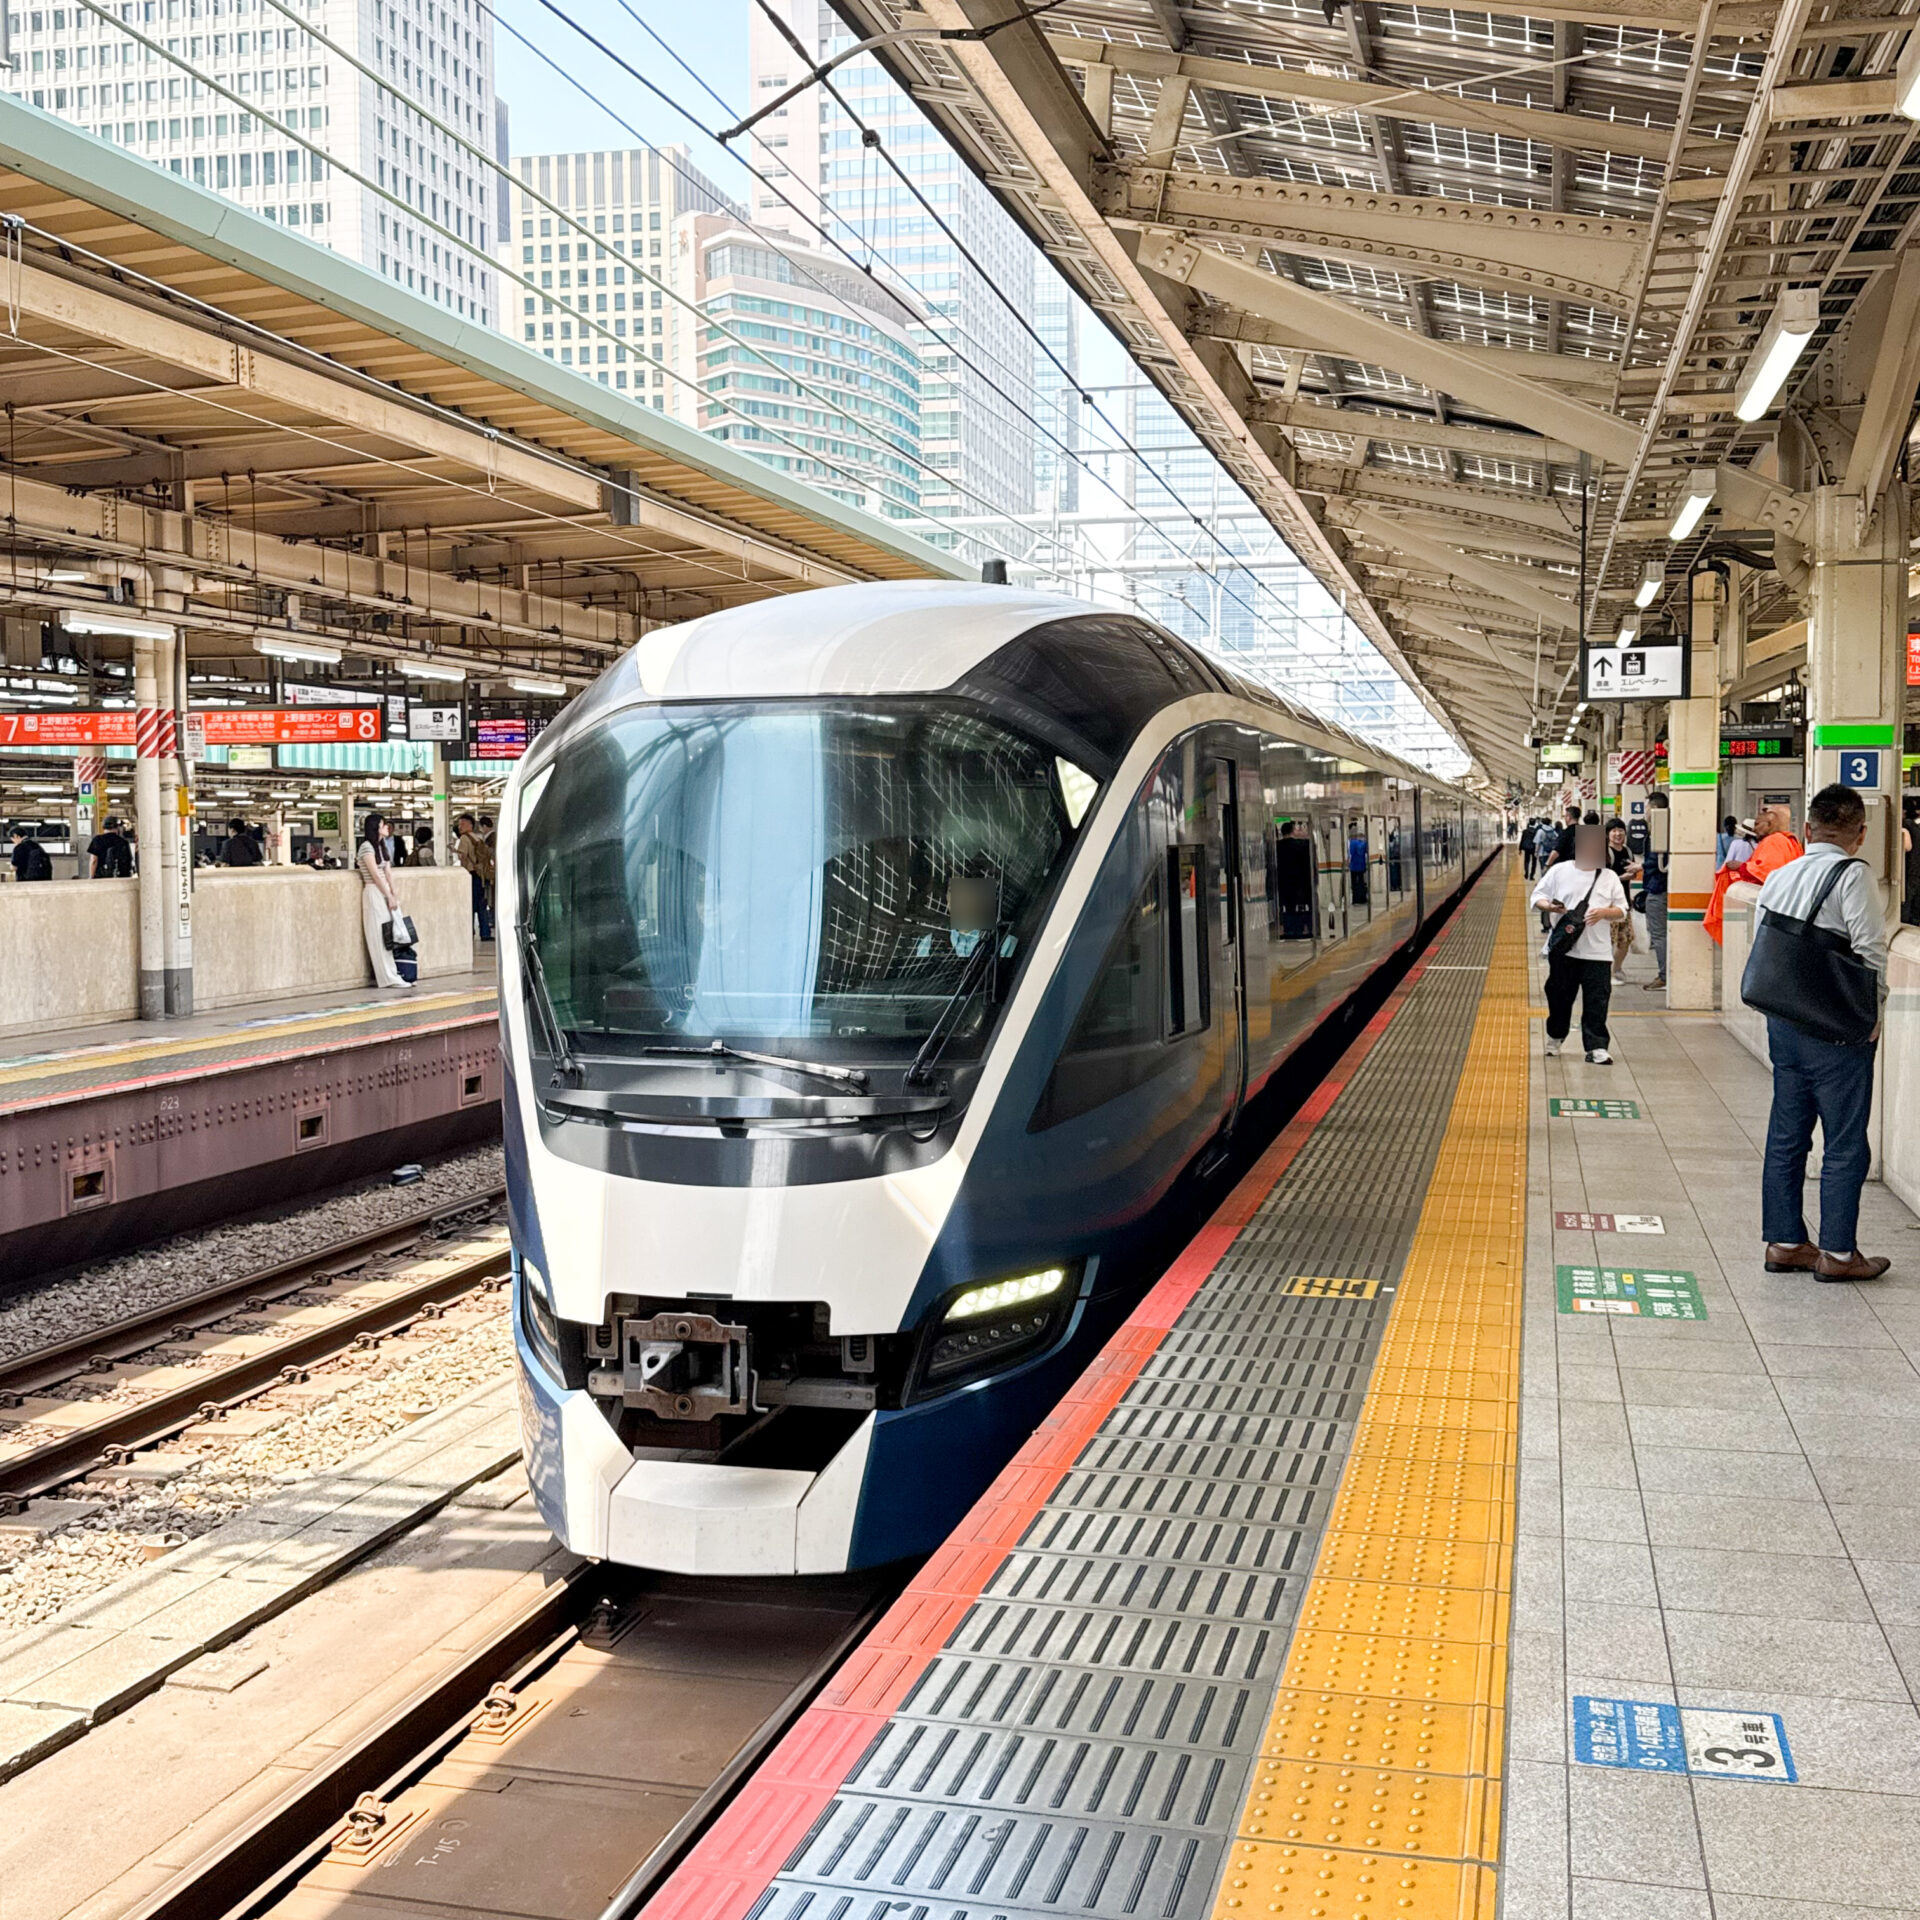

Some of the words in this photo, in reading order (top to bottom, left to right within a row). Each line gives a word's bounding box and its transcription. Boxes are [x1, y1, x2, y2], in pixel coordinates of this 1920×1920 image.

[1620, 677, 1668, 686] エレベーター
[39, 716, 91, 725] 上野東京ライン
[282, 713, 337, 723] 上野東京ライン
[4, 716, 19, 742] 7
[358, 711, 376, 739] 8
[1850, 757, 1868, 782] 3
[83, 785, 89, 793] 4
[1634, 803, 1642, 812] 4
